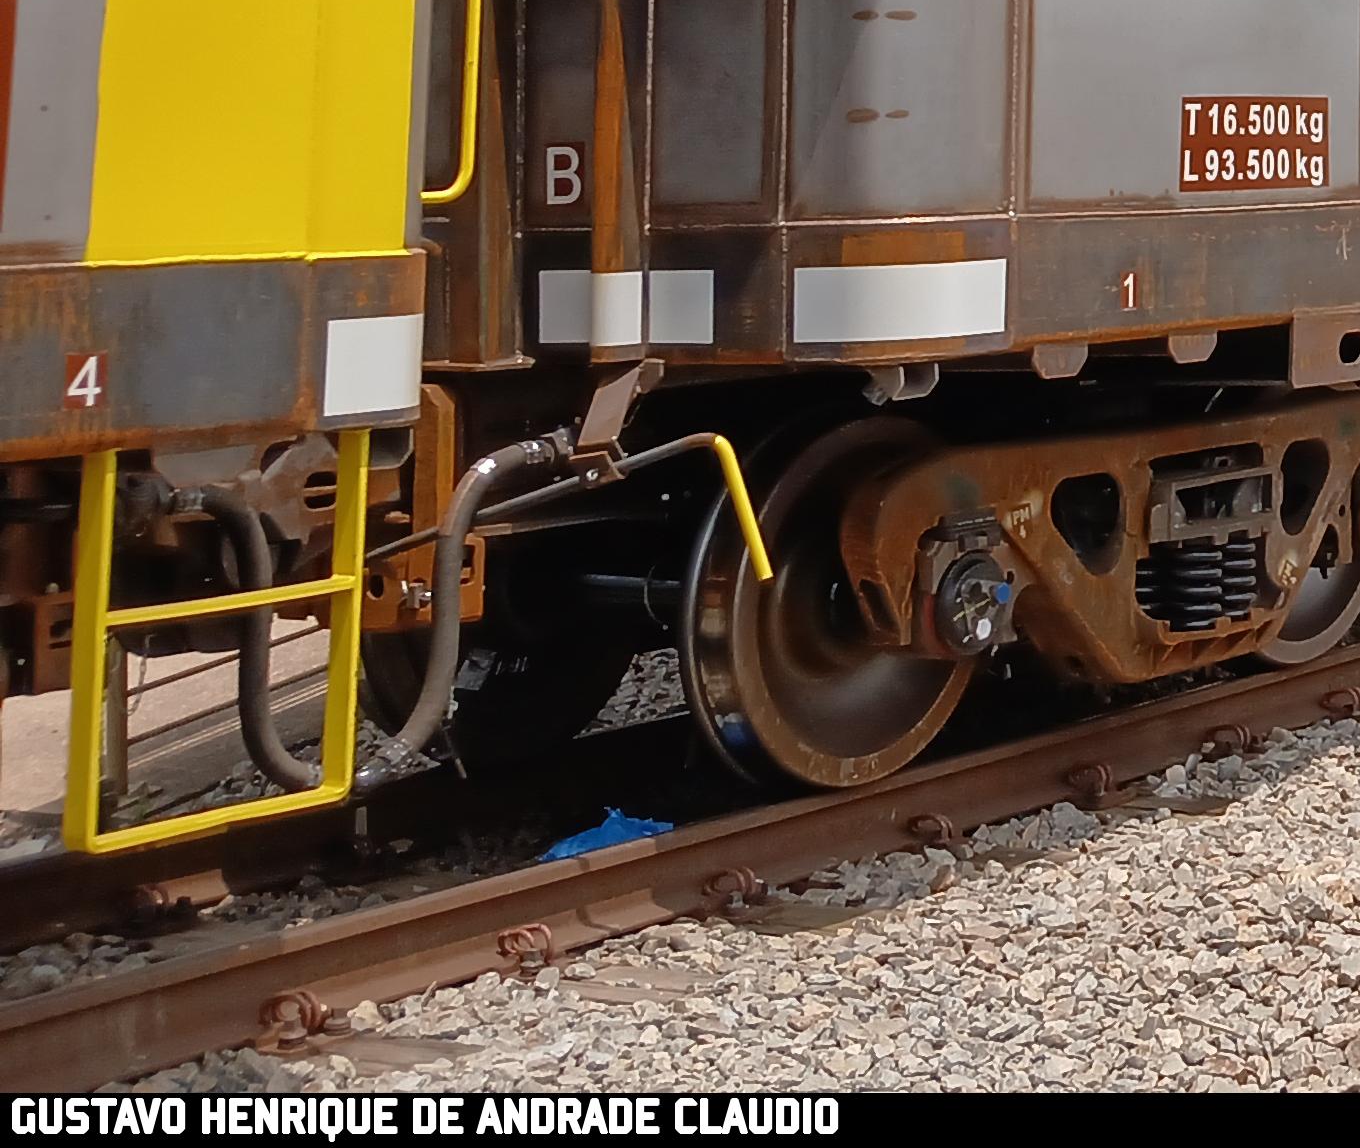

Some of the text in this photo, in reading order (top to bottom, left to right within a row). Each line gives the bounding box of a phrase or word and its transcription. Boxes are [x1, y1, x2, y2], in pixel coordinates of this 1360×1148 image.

[1185, 103, 1324, 143] T 16.500 kg
[546, 146, 582, 205] B
[1183, 148, 1324, 186] L 93.500 kg
[1123, 273, 1134, 308] 1
[67, 355, 102, 407] 4
